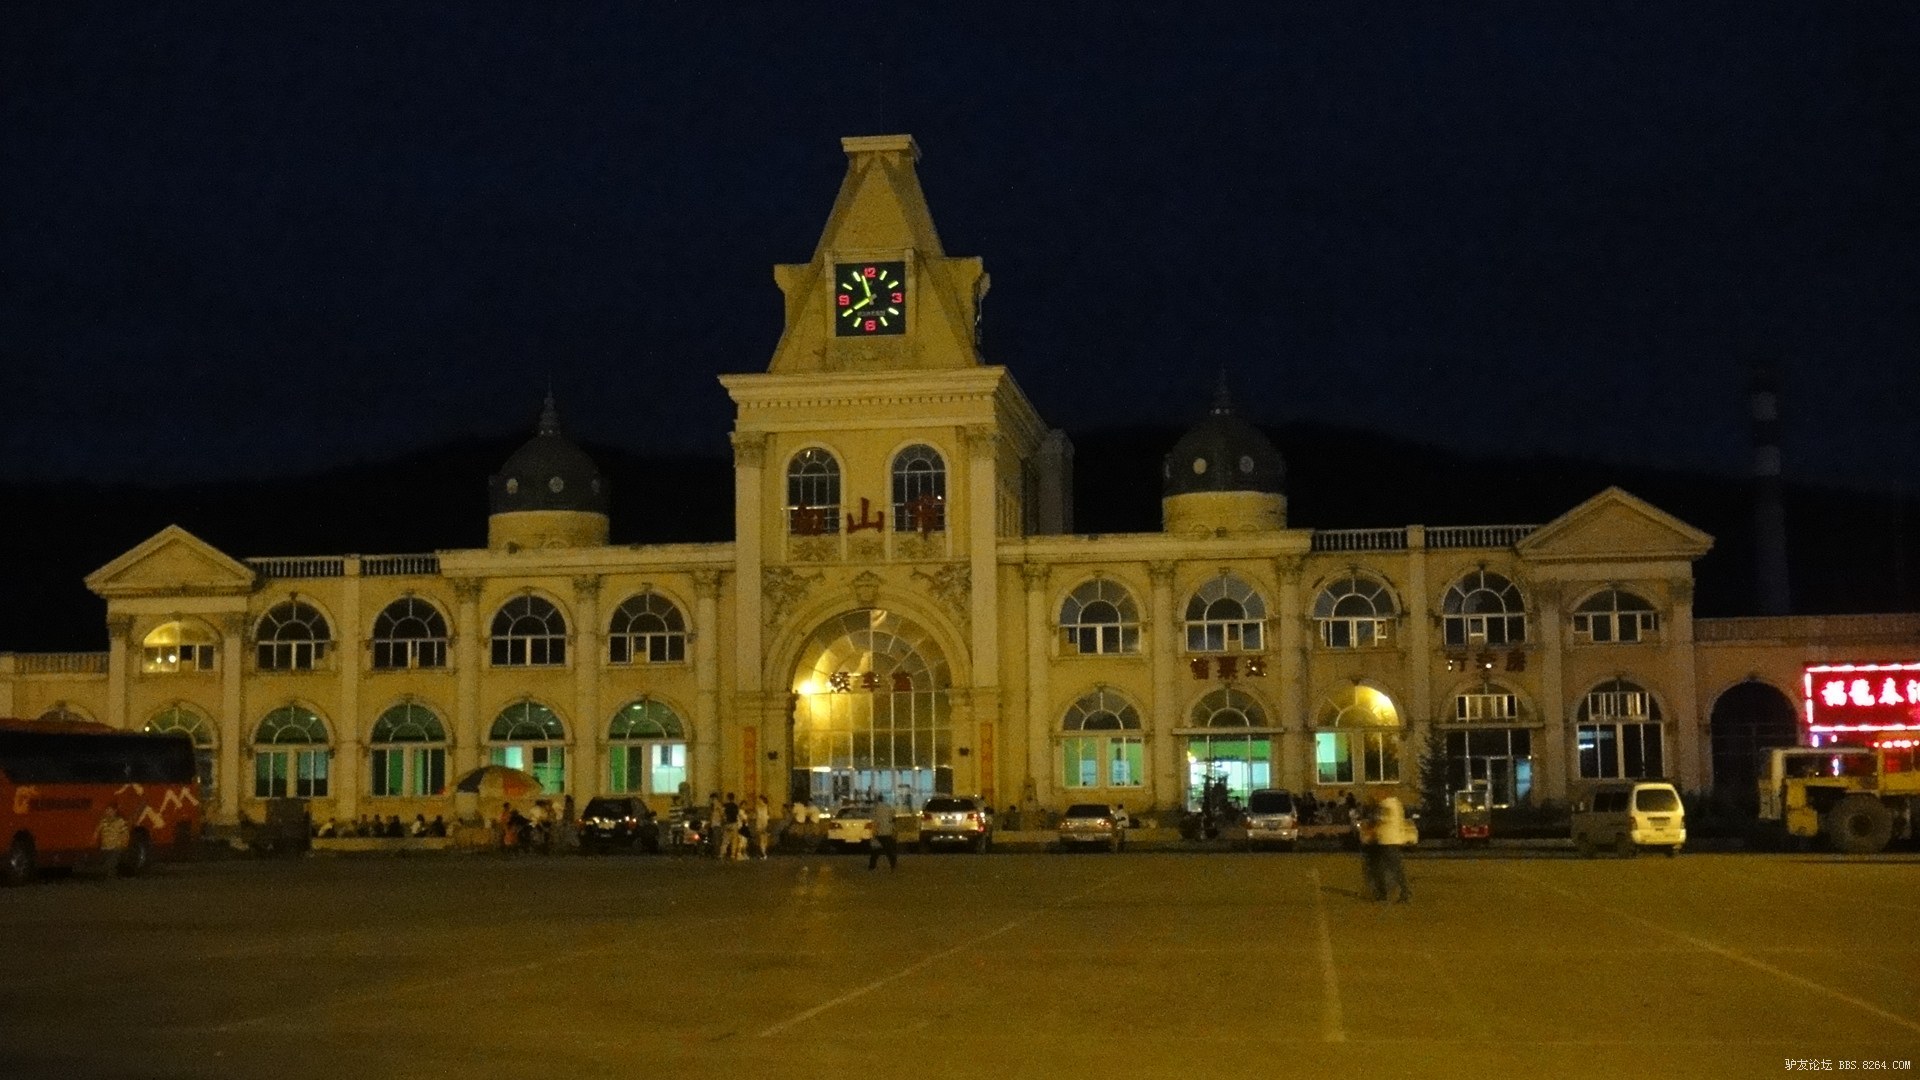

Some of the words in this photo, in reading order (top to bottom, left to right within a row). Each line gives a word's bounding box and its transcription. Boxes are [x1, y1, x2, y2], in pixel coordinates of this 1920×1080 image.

[864, 267, 876, 278] 12
[838, 294, 850, 306] 9
[891, 292, 902, 304] 3
[864, 320, 876, 331] 6
